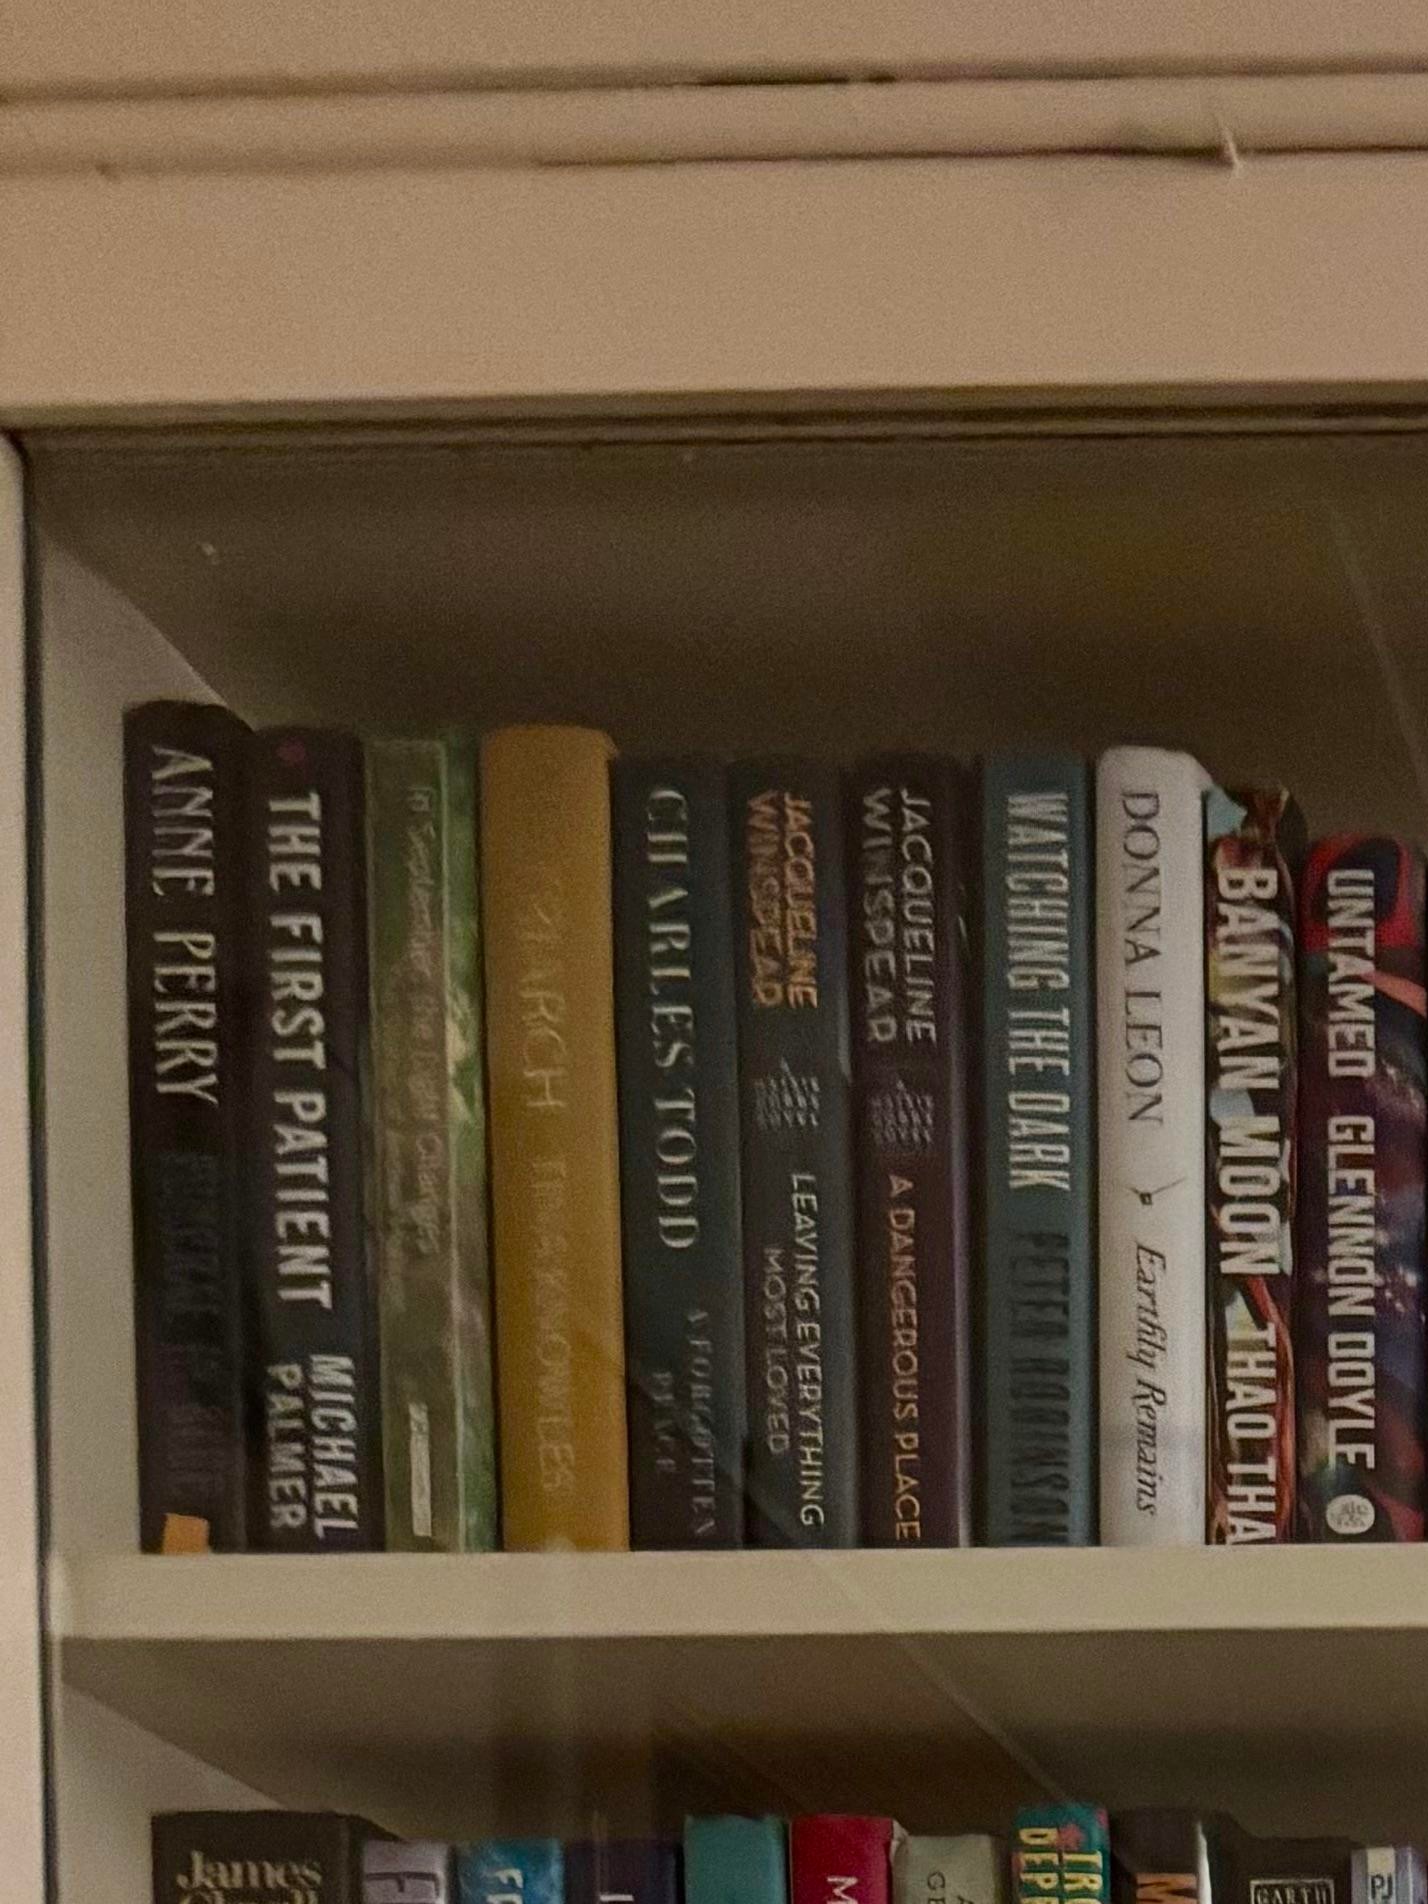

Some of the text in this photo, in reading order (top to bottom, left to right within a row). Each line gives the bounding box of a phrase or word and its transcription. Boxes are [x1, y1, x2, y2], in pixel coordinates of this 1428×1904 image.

[150, 745, 216, 898] ANNE
[152, 931, 220, 1108] PERRY
[267, 792, 333, 1310] THE FIRST PATIENT
[1004, 791, 1070, 1190] WATCHING THE DARK
[1121, 790, 1165, 1125] DONNA LEON
[1217, 866, 1281, 1275] BANYAN MOON
[1325, 868, 1377, 1469] UNTAMED GLENNON DOYLE
[265, 1362, 307, 1529] PALMER
[307, 1353, 359, 1537] MICHAEL
[178, 1849, 323, 1892] James
